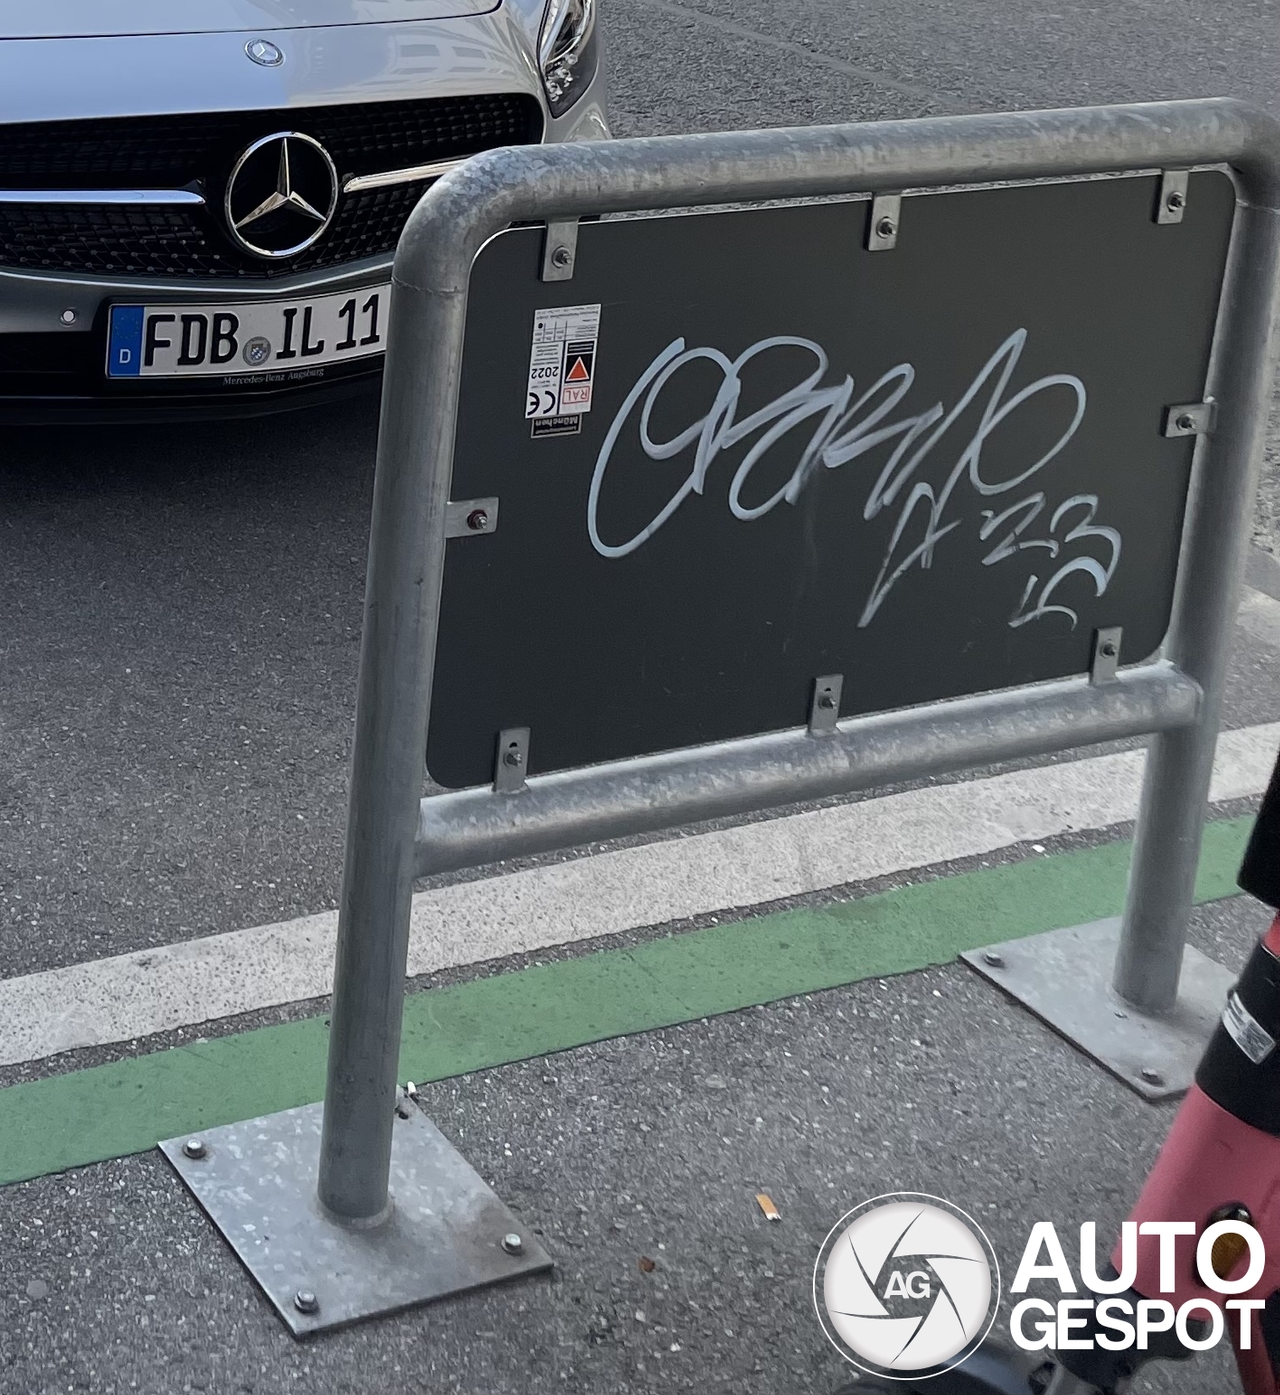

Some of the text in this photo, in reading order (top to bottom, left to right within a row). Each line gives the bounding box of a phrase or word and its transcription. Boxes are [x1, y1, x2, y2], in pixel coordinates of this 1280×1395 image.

[144, 293, 380, 367] FDB IL 11
[119, 348, 131, 363] D
[223, 367, 325, 386] Mercedes-Benz Augsburg
[531, 366, 559, 380] 2022
[566, 389, 588, 399] RAL
[535, 414, 579, 428] München
